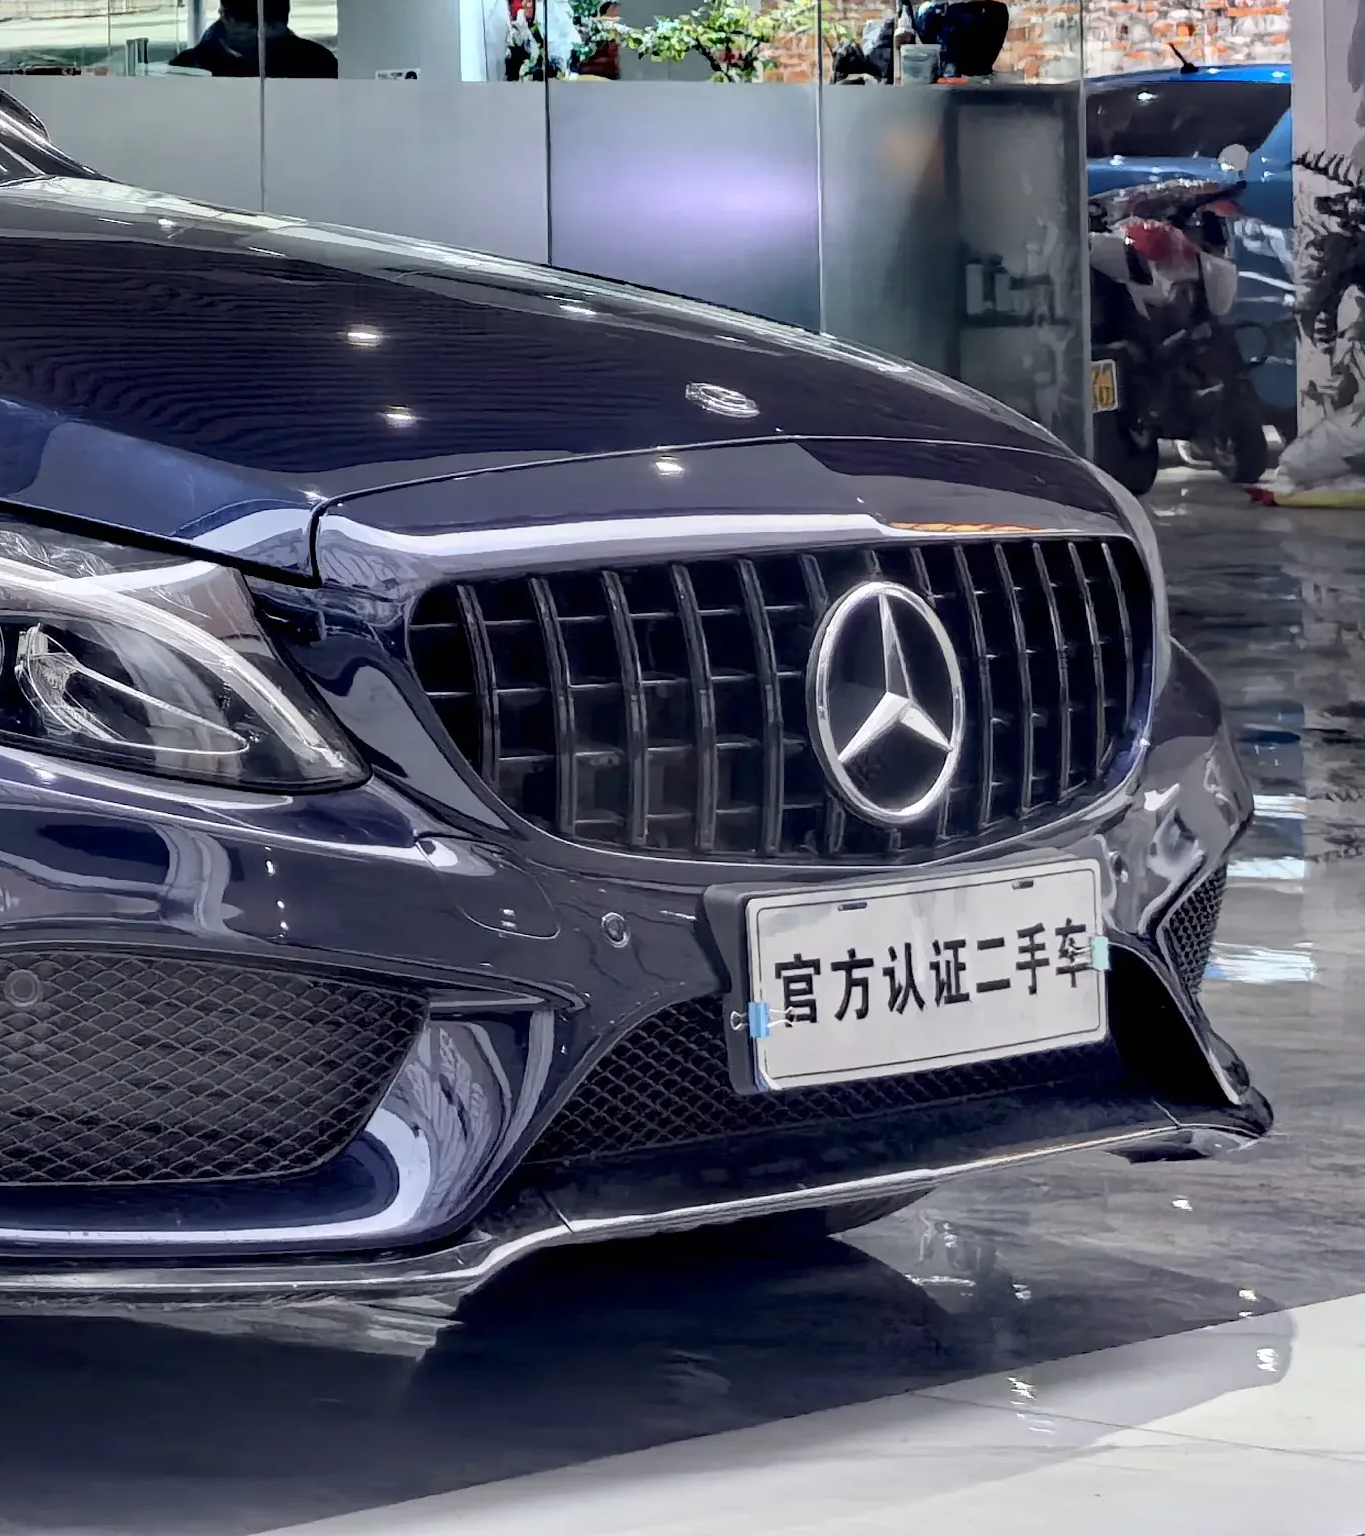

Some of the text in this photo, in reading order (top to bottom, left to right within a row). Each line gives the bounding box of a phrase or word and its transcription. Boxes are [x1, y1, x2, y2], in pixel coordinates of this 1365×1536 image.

[773, 917, 1093, 1028] 官方认证二手车
